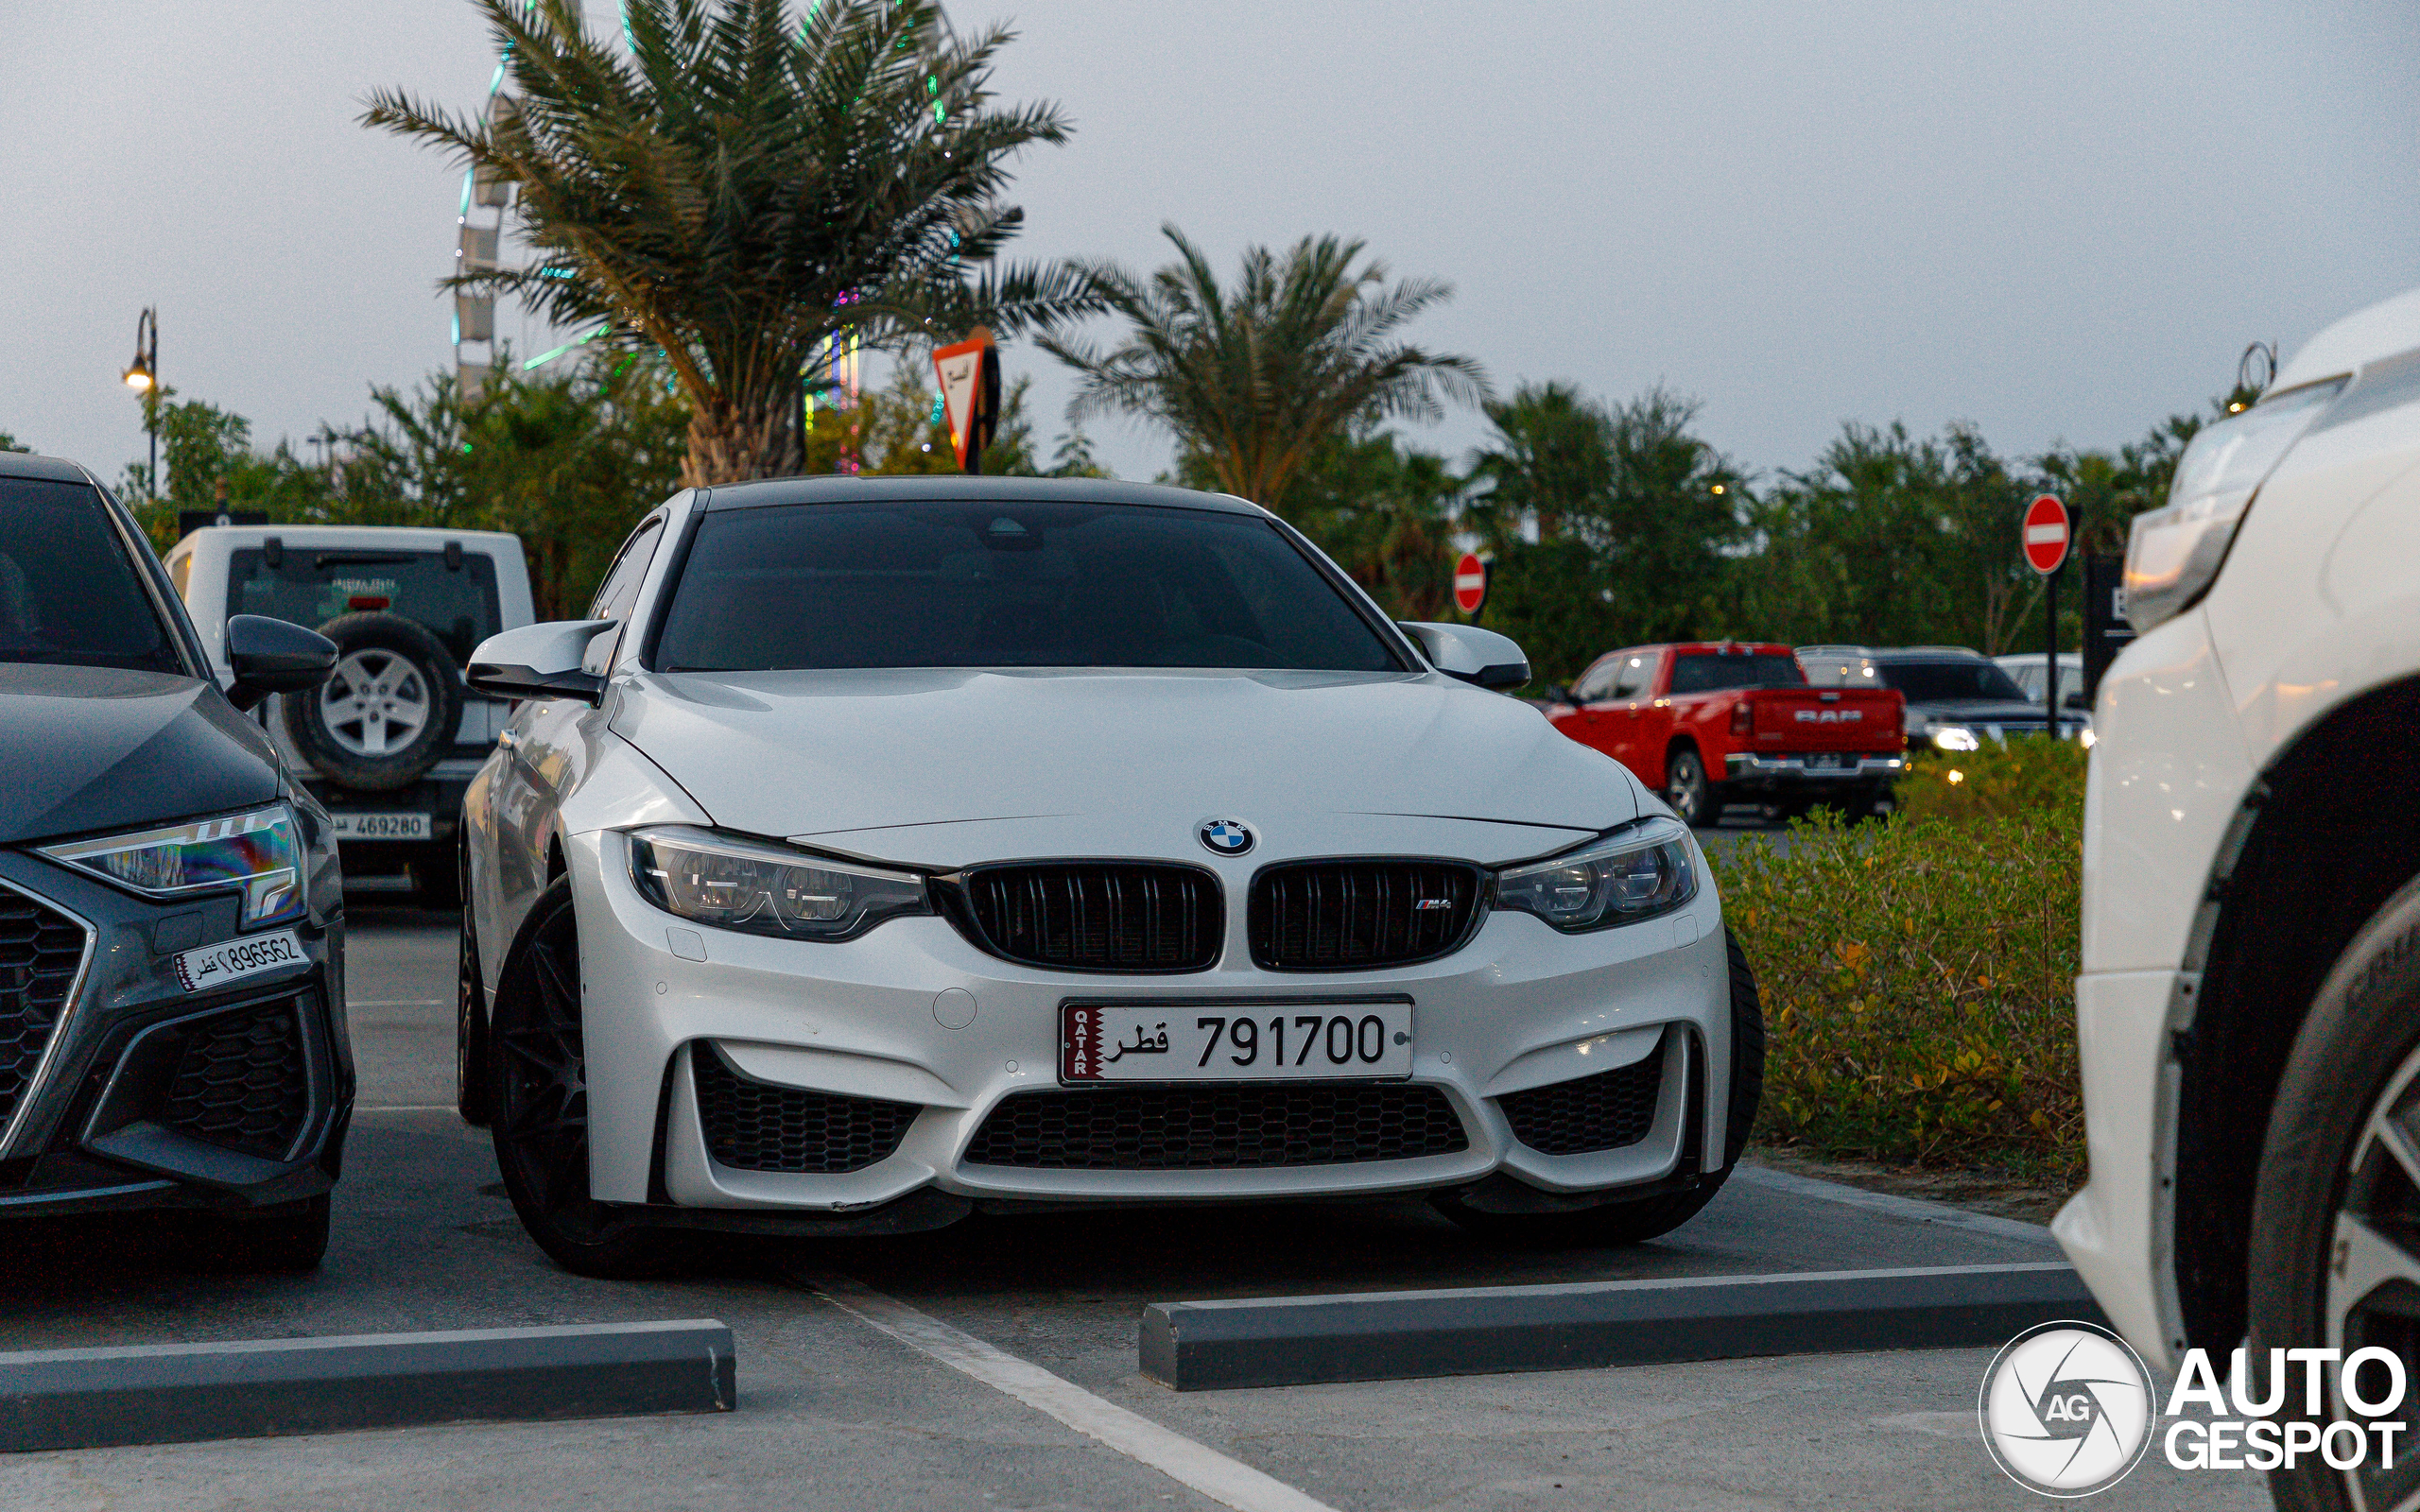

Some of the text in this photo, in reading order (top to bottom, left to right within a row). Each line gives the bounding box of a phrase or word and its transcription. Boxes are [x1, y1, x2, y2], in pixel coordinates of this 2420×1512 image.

[1794, 710, 1862, 723] RAM
[357, 816, 421, 834] 469280
[1203, 820, 1247, 832] BMW
[196, 937, 300, 980] قطر 896562
[1074, 1010, 1087, 1074] QATAR
[1103, 1014, 1385, 1067] قطر 791700
